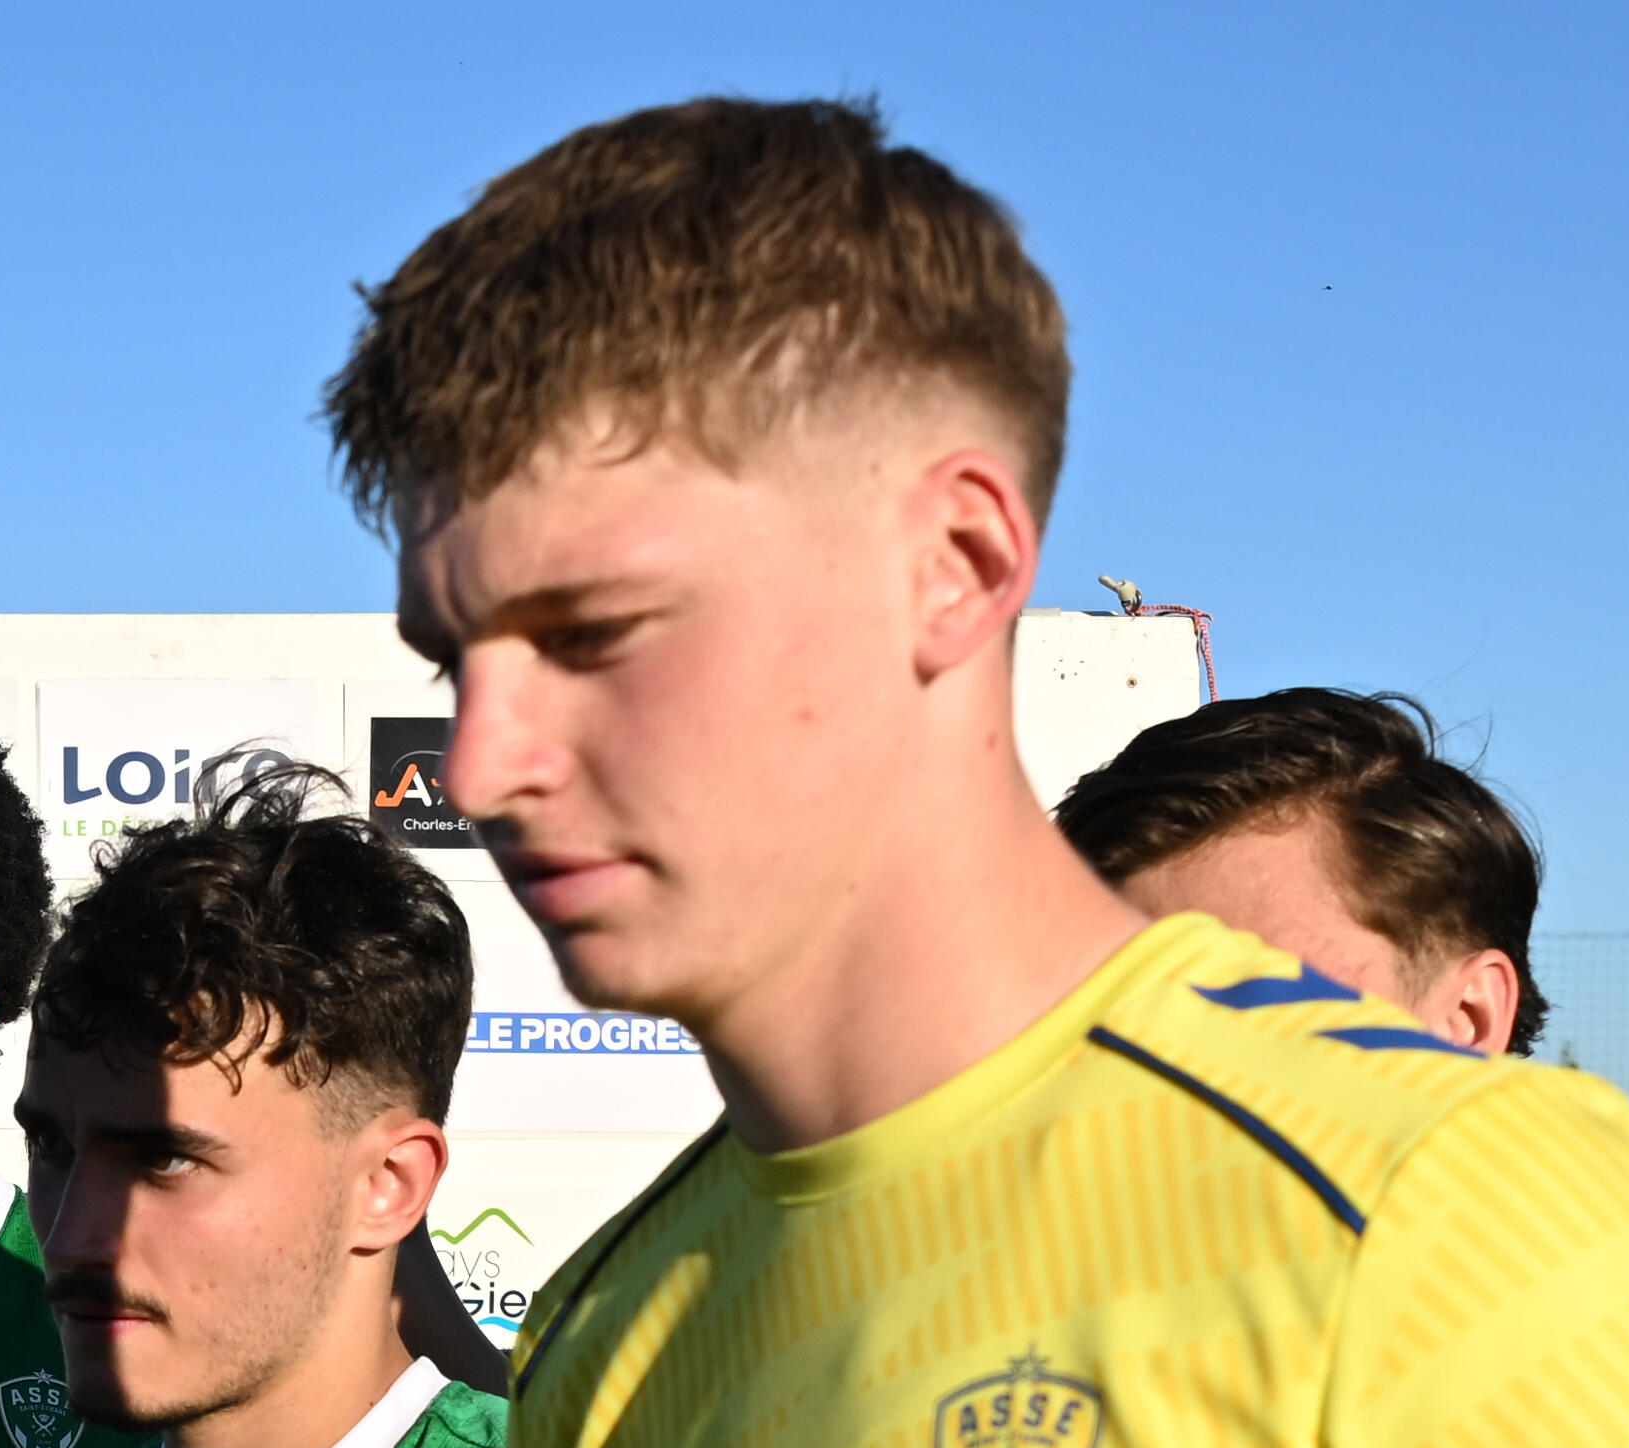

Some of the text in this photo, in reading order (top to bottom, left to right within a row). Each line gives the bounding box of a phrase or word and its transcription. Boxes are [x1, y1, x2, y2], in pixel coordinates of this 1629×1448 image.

[62, 819, 87, 837] LE
[403, 816, 475, 831] Charles-Ér
[11, 1387, 70, 1409] ASS
[949, 1393, 1082, 1437] ASSE
